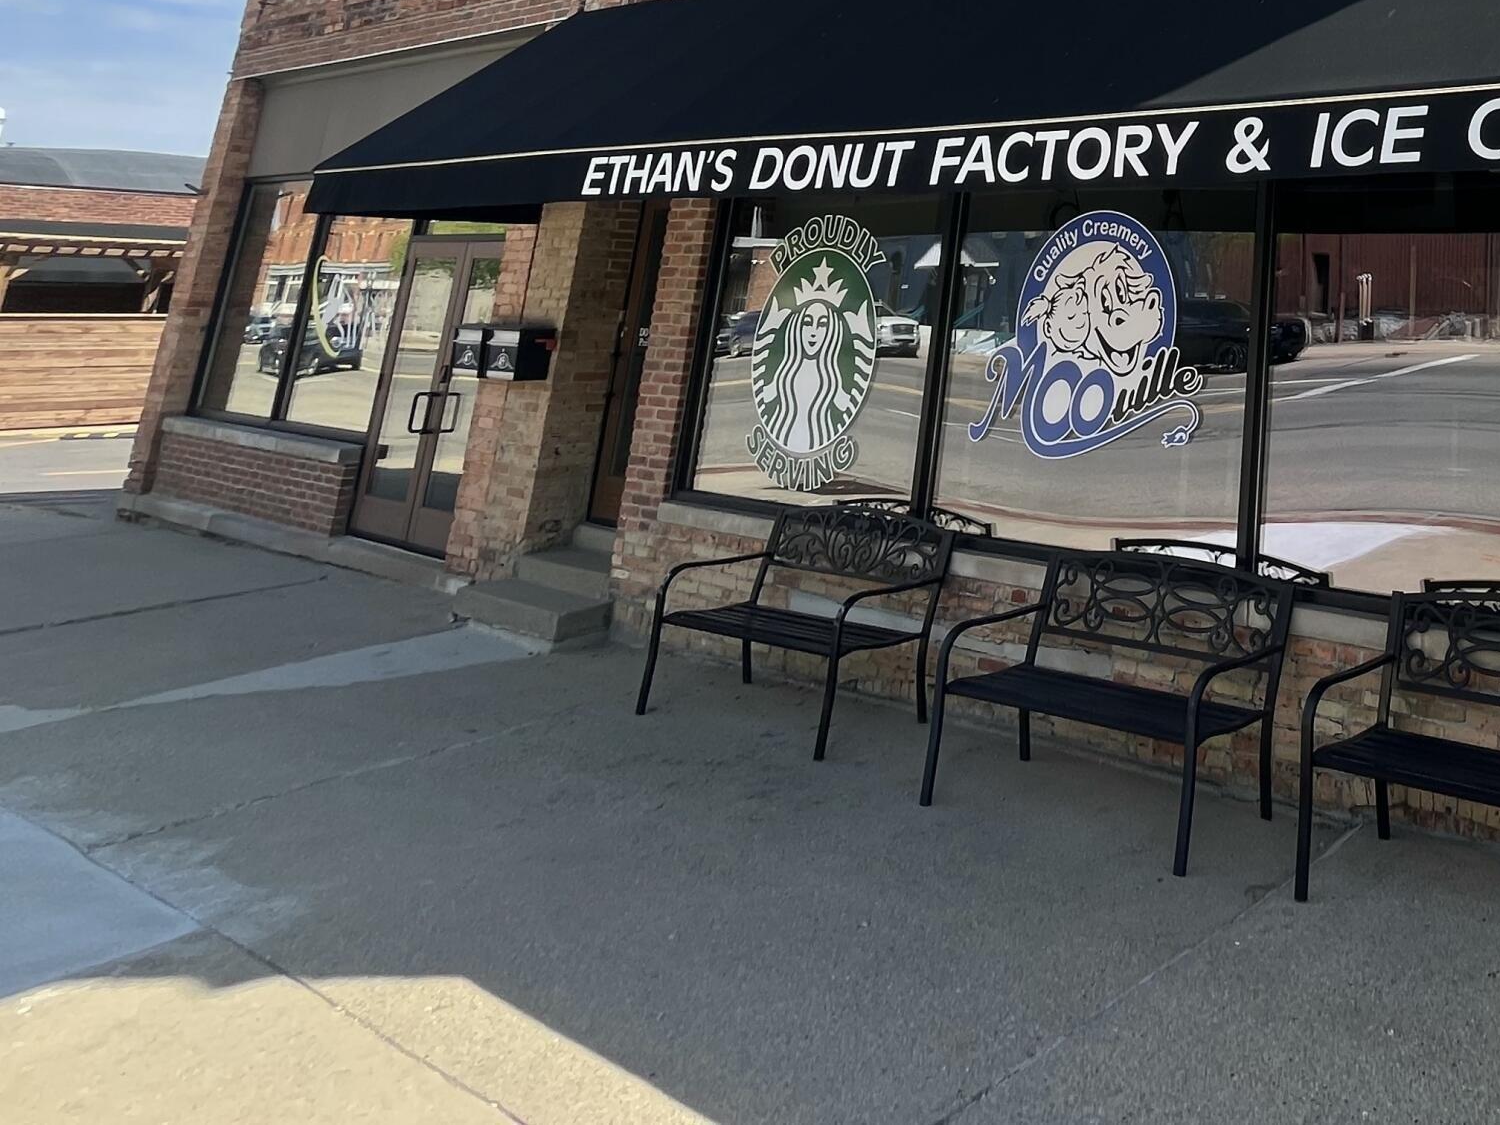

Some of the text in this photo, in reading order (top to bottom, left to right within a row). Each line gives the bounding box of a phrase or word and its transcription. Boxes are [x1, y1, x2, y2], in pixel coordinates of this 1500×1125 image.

[580, 148, 738, 196] ETHAN'S
[748, 140, 917, 191] DONUT
[928, 120, 1201, 186] FACTORY
[1225, 116, 1271, 174] &
[1309, 105, 1430, 168] ICE
[769, 214, 887, 276] PROUDLY
[1033, 219, 1153, 282] Quality Creamery
[745, 424, 855, 492] SERVING
